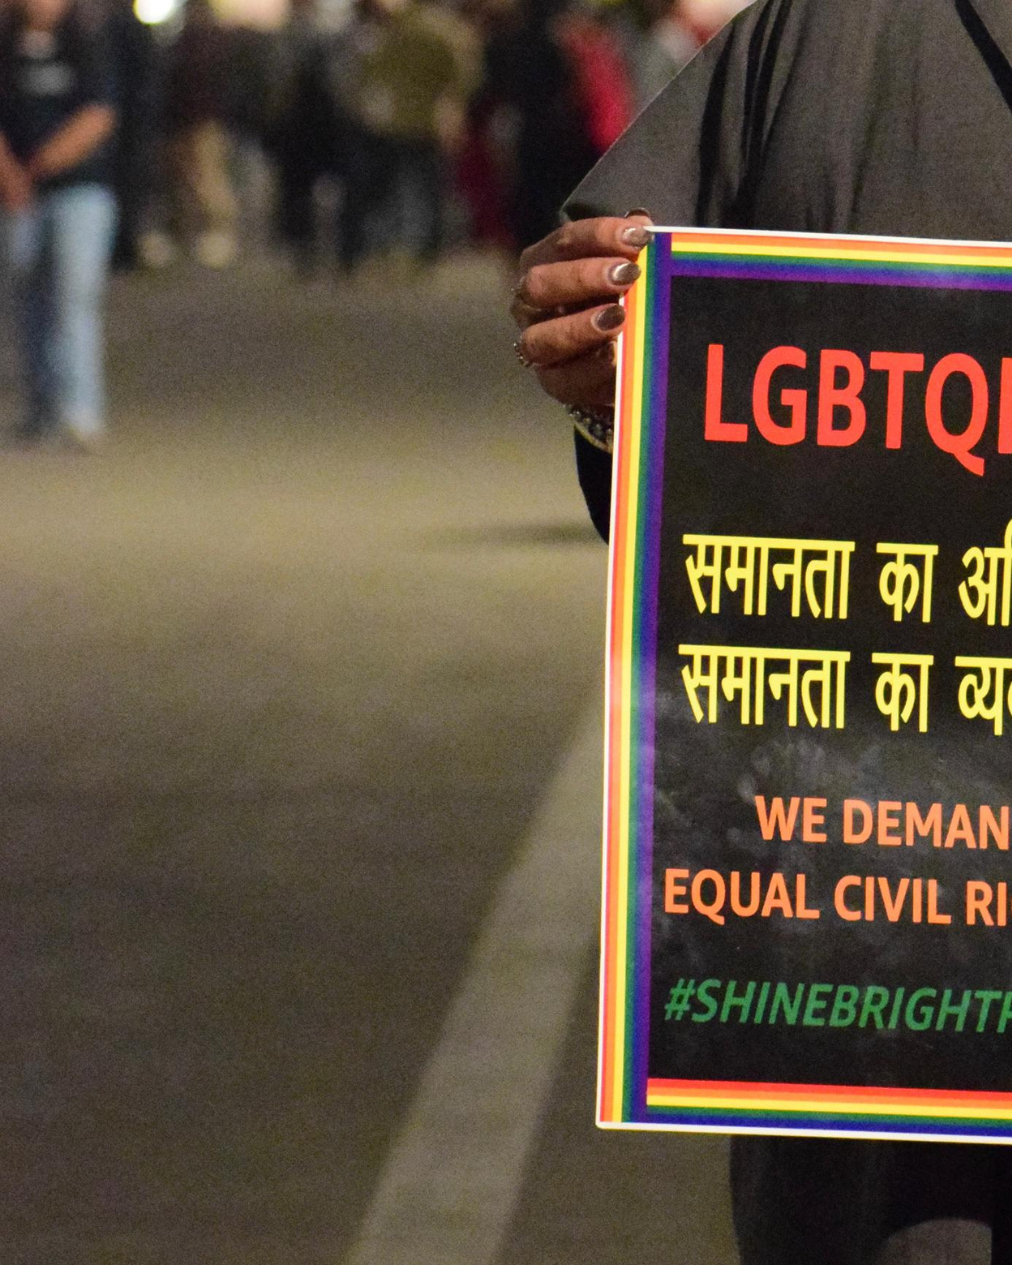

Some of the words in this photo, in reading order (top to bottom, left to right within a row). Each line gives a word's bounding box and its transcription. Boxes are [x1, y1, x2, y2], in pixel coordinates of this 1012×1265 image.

[682, 534, 856, 619] समानता
[876, 542, 939, 623] का
[678, 644, 851, 730] समानता
[871, 652, 934, 733] का
[754, 794, 828, 844] WE
[663, 867, 821, 926] EQUAL
[833, 875, 953, 926] CIVIL
